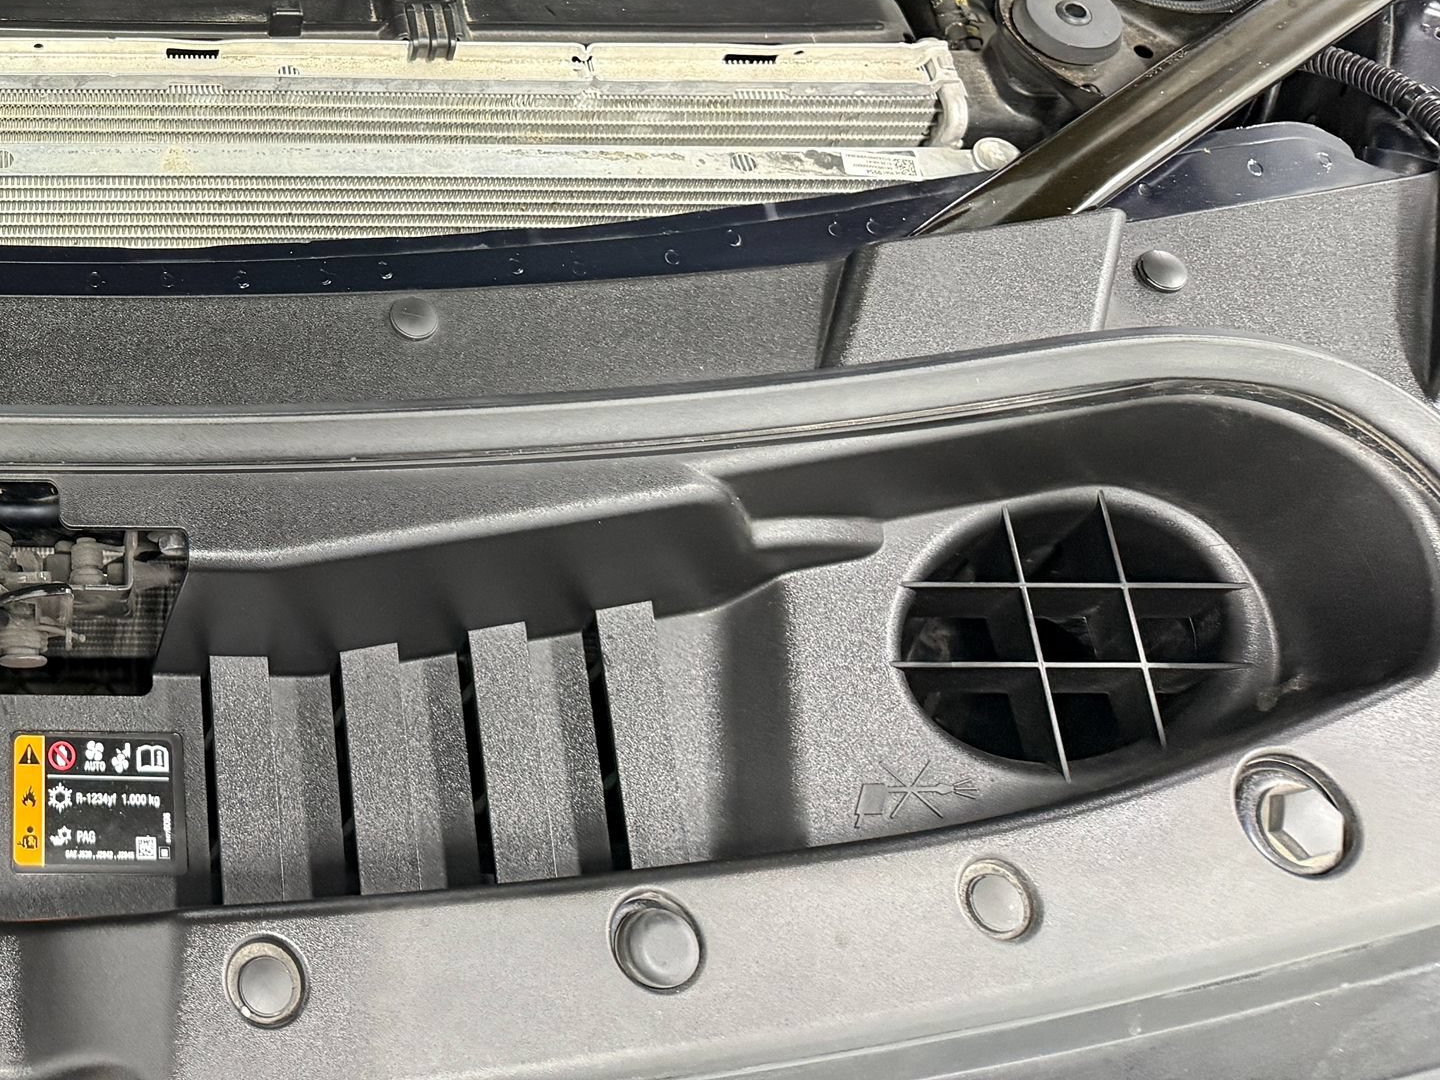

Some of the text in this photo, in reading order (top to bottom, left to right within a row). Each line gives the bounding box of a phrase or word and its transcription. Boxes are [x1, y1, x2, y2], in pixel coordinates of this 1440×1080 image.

[84, 760, 106, 772] AUTO
[75, 792, 160, 808] R-1234yf 1.000 kg
[76, 830, 96, 844] PAG
